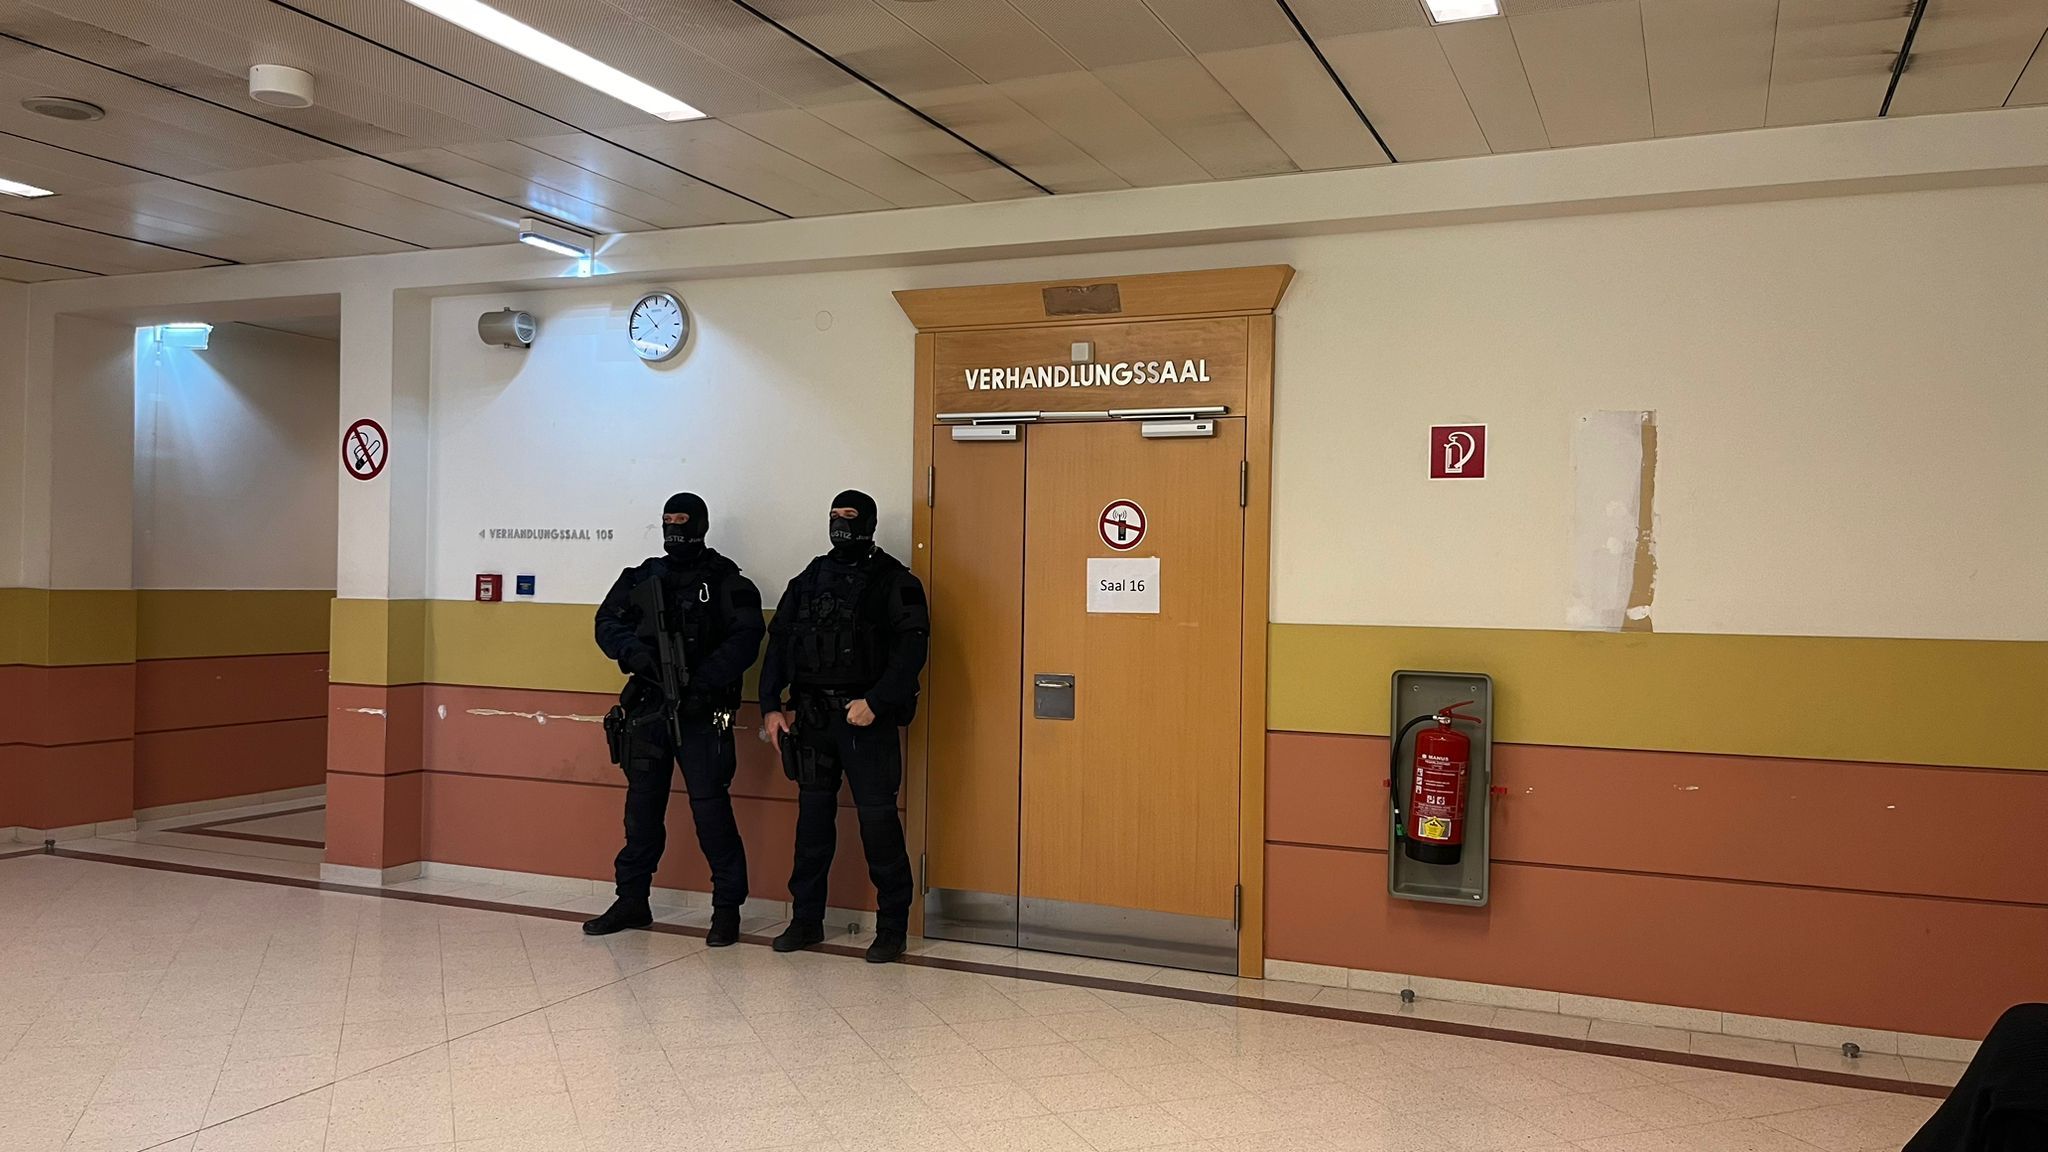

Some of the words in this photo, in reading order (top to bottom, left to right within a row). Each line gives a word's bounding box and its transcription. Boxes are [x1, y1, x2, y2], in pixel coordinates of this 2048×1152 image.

[965, 359, 1210, 390] VERHANDLUNGSSAAL
[489, 528, 590, 540] VERHANDLUNGSSAAL
[595, 529, 613, 540] 105
[1100, 579, 1125, 592] Saal
[1129, 579, 1145, 592] 16
